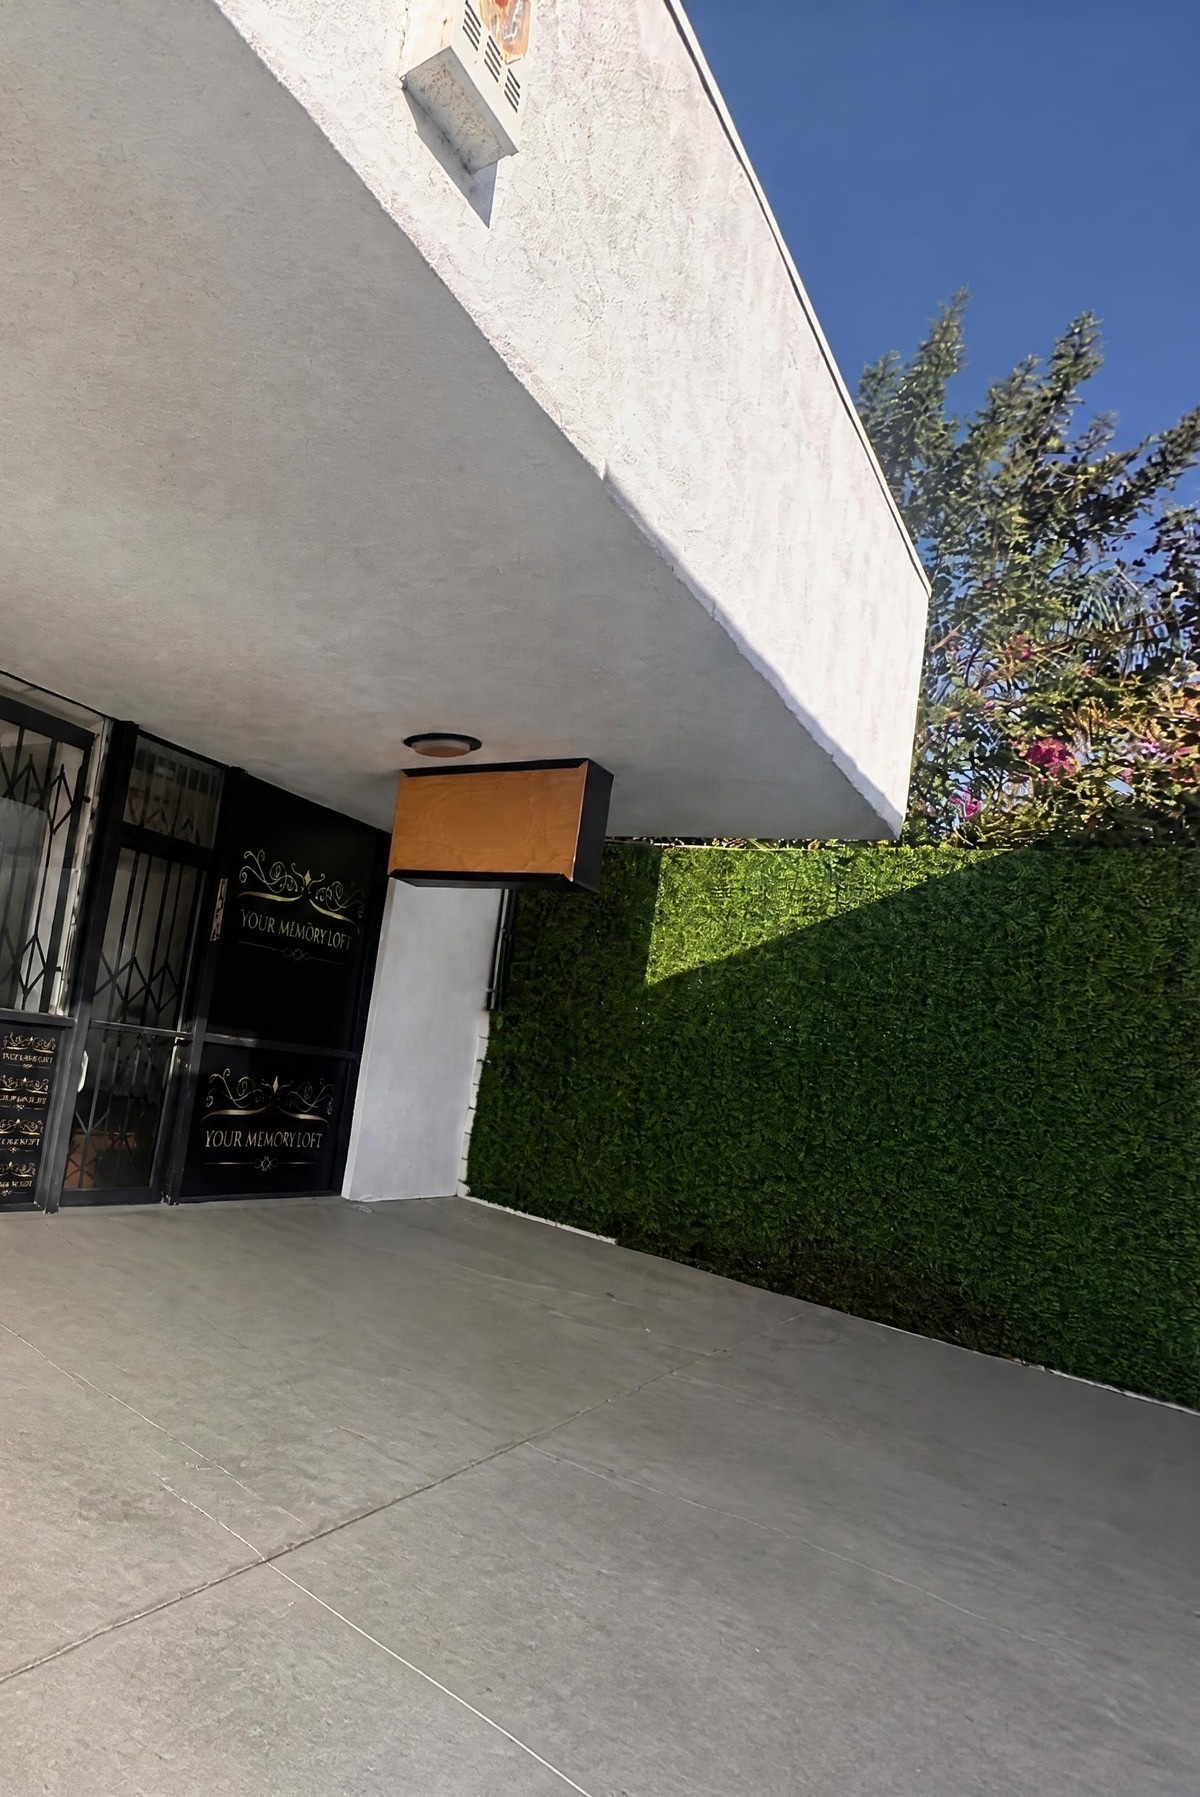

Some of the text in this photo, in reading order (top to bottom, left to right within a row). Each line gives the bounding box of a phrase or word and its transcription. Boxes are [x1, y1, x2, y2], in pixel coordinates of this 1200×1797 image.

[241, 908, 353, 950] YOUR MEMORY LOFT
[205, 1130, 323, 1148] YOUR MEMORY LOFT
